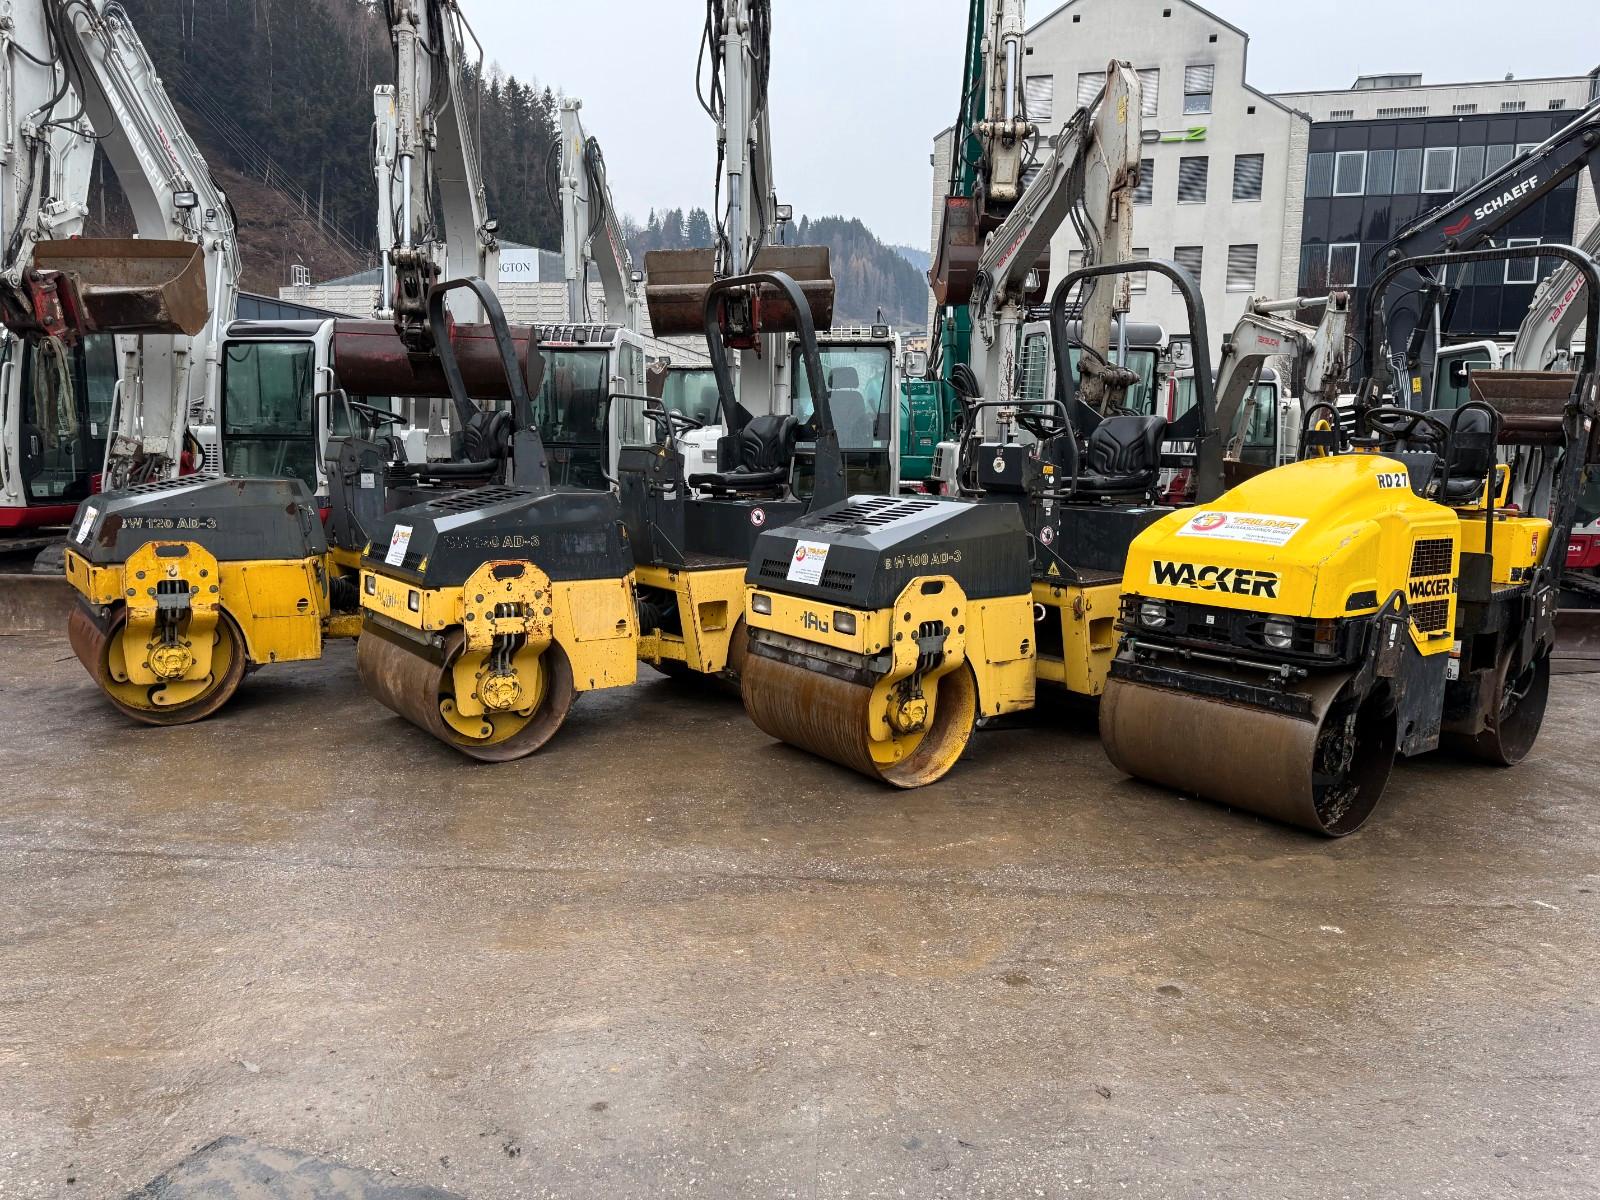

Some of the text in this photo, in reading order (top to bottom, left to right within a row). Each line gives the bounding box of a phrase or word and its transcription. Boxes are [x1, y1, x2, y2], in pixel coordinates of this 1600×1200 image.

[1474, 175, 1538, 220] SCHAEFF
[1548, 270, 1586, 324] TAKEUC
[177, 517, 216, 529] AD-3
[502, 535, 540, 548] AD-3
[930, 549, 962, 565] AD-3
[1153, 560, 1278, 598] WACKER
[1408, 578, 1450, 599] WACKER
